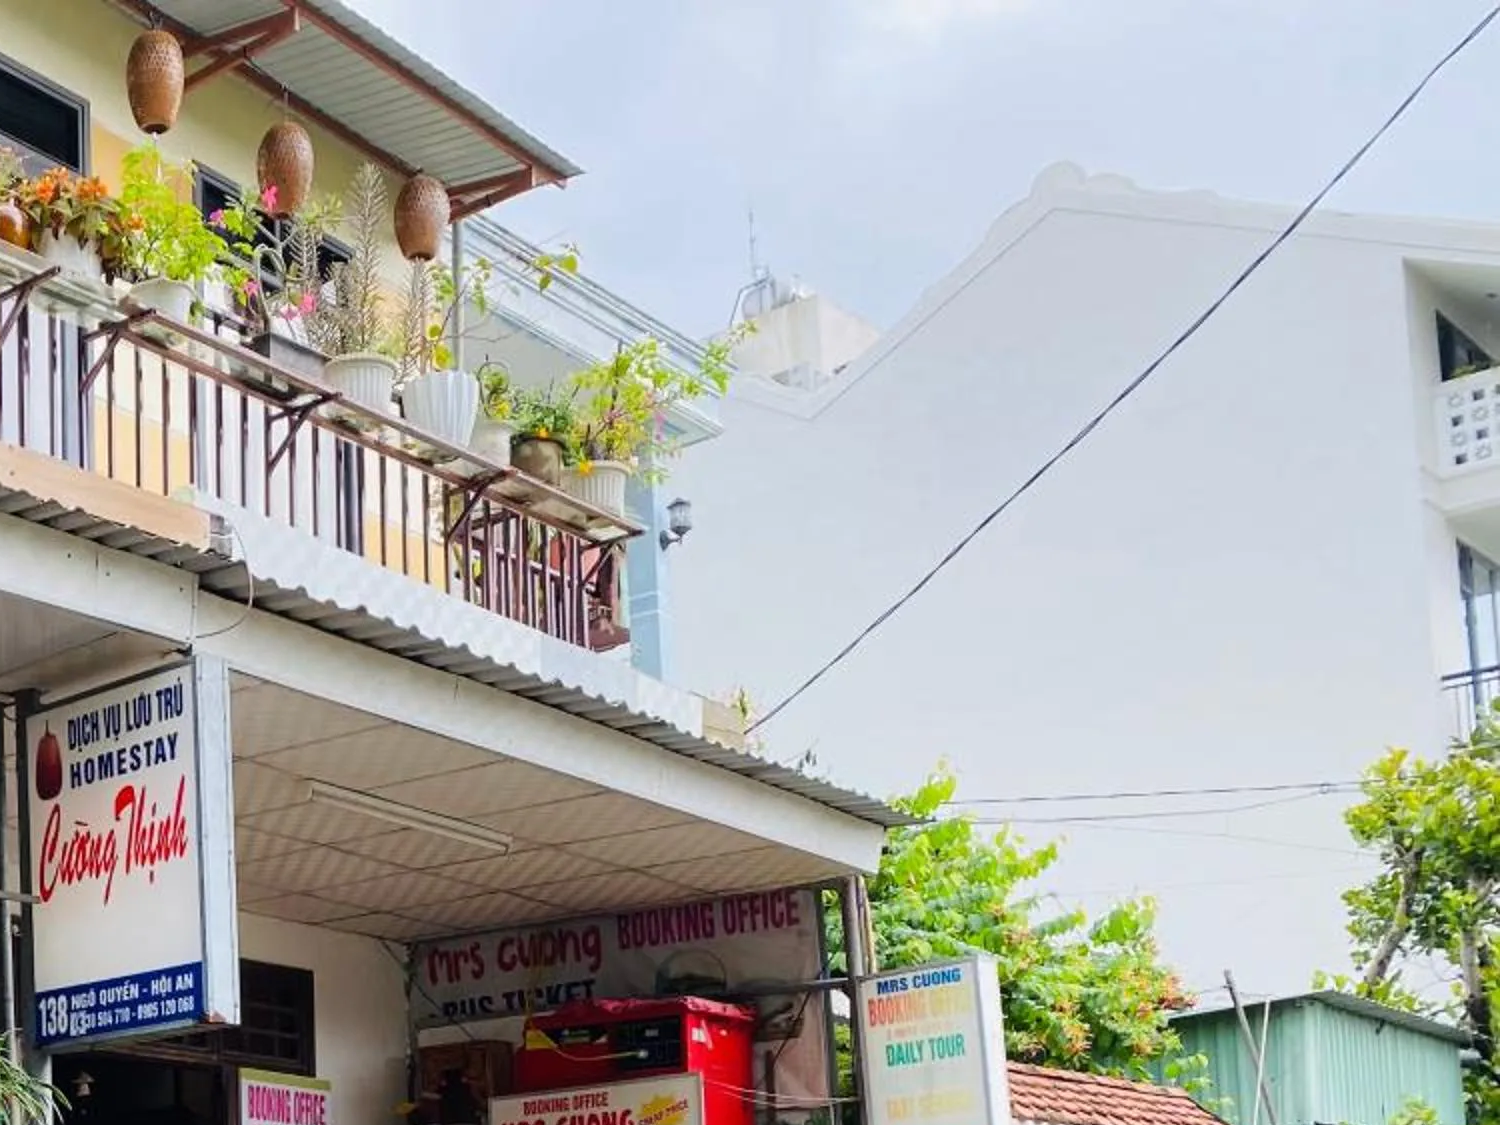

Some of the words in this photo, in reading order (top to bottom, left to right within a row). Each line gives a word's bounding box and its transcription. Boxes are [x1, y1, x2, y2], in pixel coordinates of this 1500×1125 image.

[67, 713, 100, 753] DỊCH
[103, 703, 122, 742] VỤ
[70, 732, 179, 789] HOMESTAY
[114, 773, 188, 884] Thịnh
[428, 942, 485, 985] Mrs
[617, 898, 714, 950] BOOKING
[723, 888, 800, 932] OFFICE
[38, 994, 68, 1036] 138
[151, 975, 173, 998] HỘI
[175, 972, 194, 991] AN
[877, 977, 909, 994] MRS
[912, 968, 962, 989] CUONG
[885, 1041, 924, 1068] DAILY
[928, 1034, 966, 1061] TOUR
[248, 1085, 291, 1124] BOOKING
[523, 1098, 570, 1116] BOOKING
[572, 1092, 610, 1109] OFFICE
